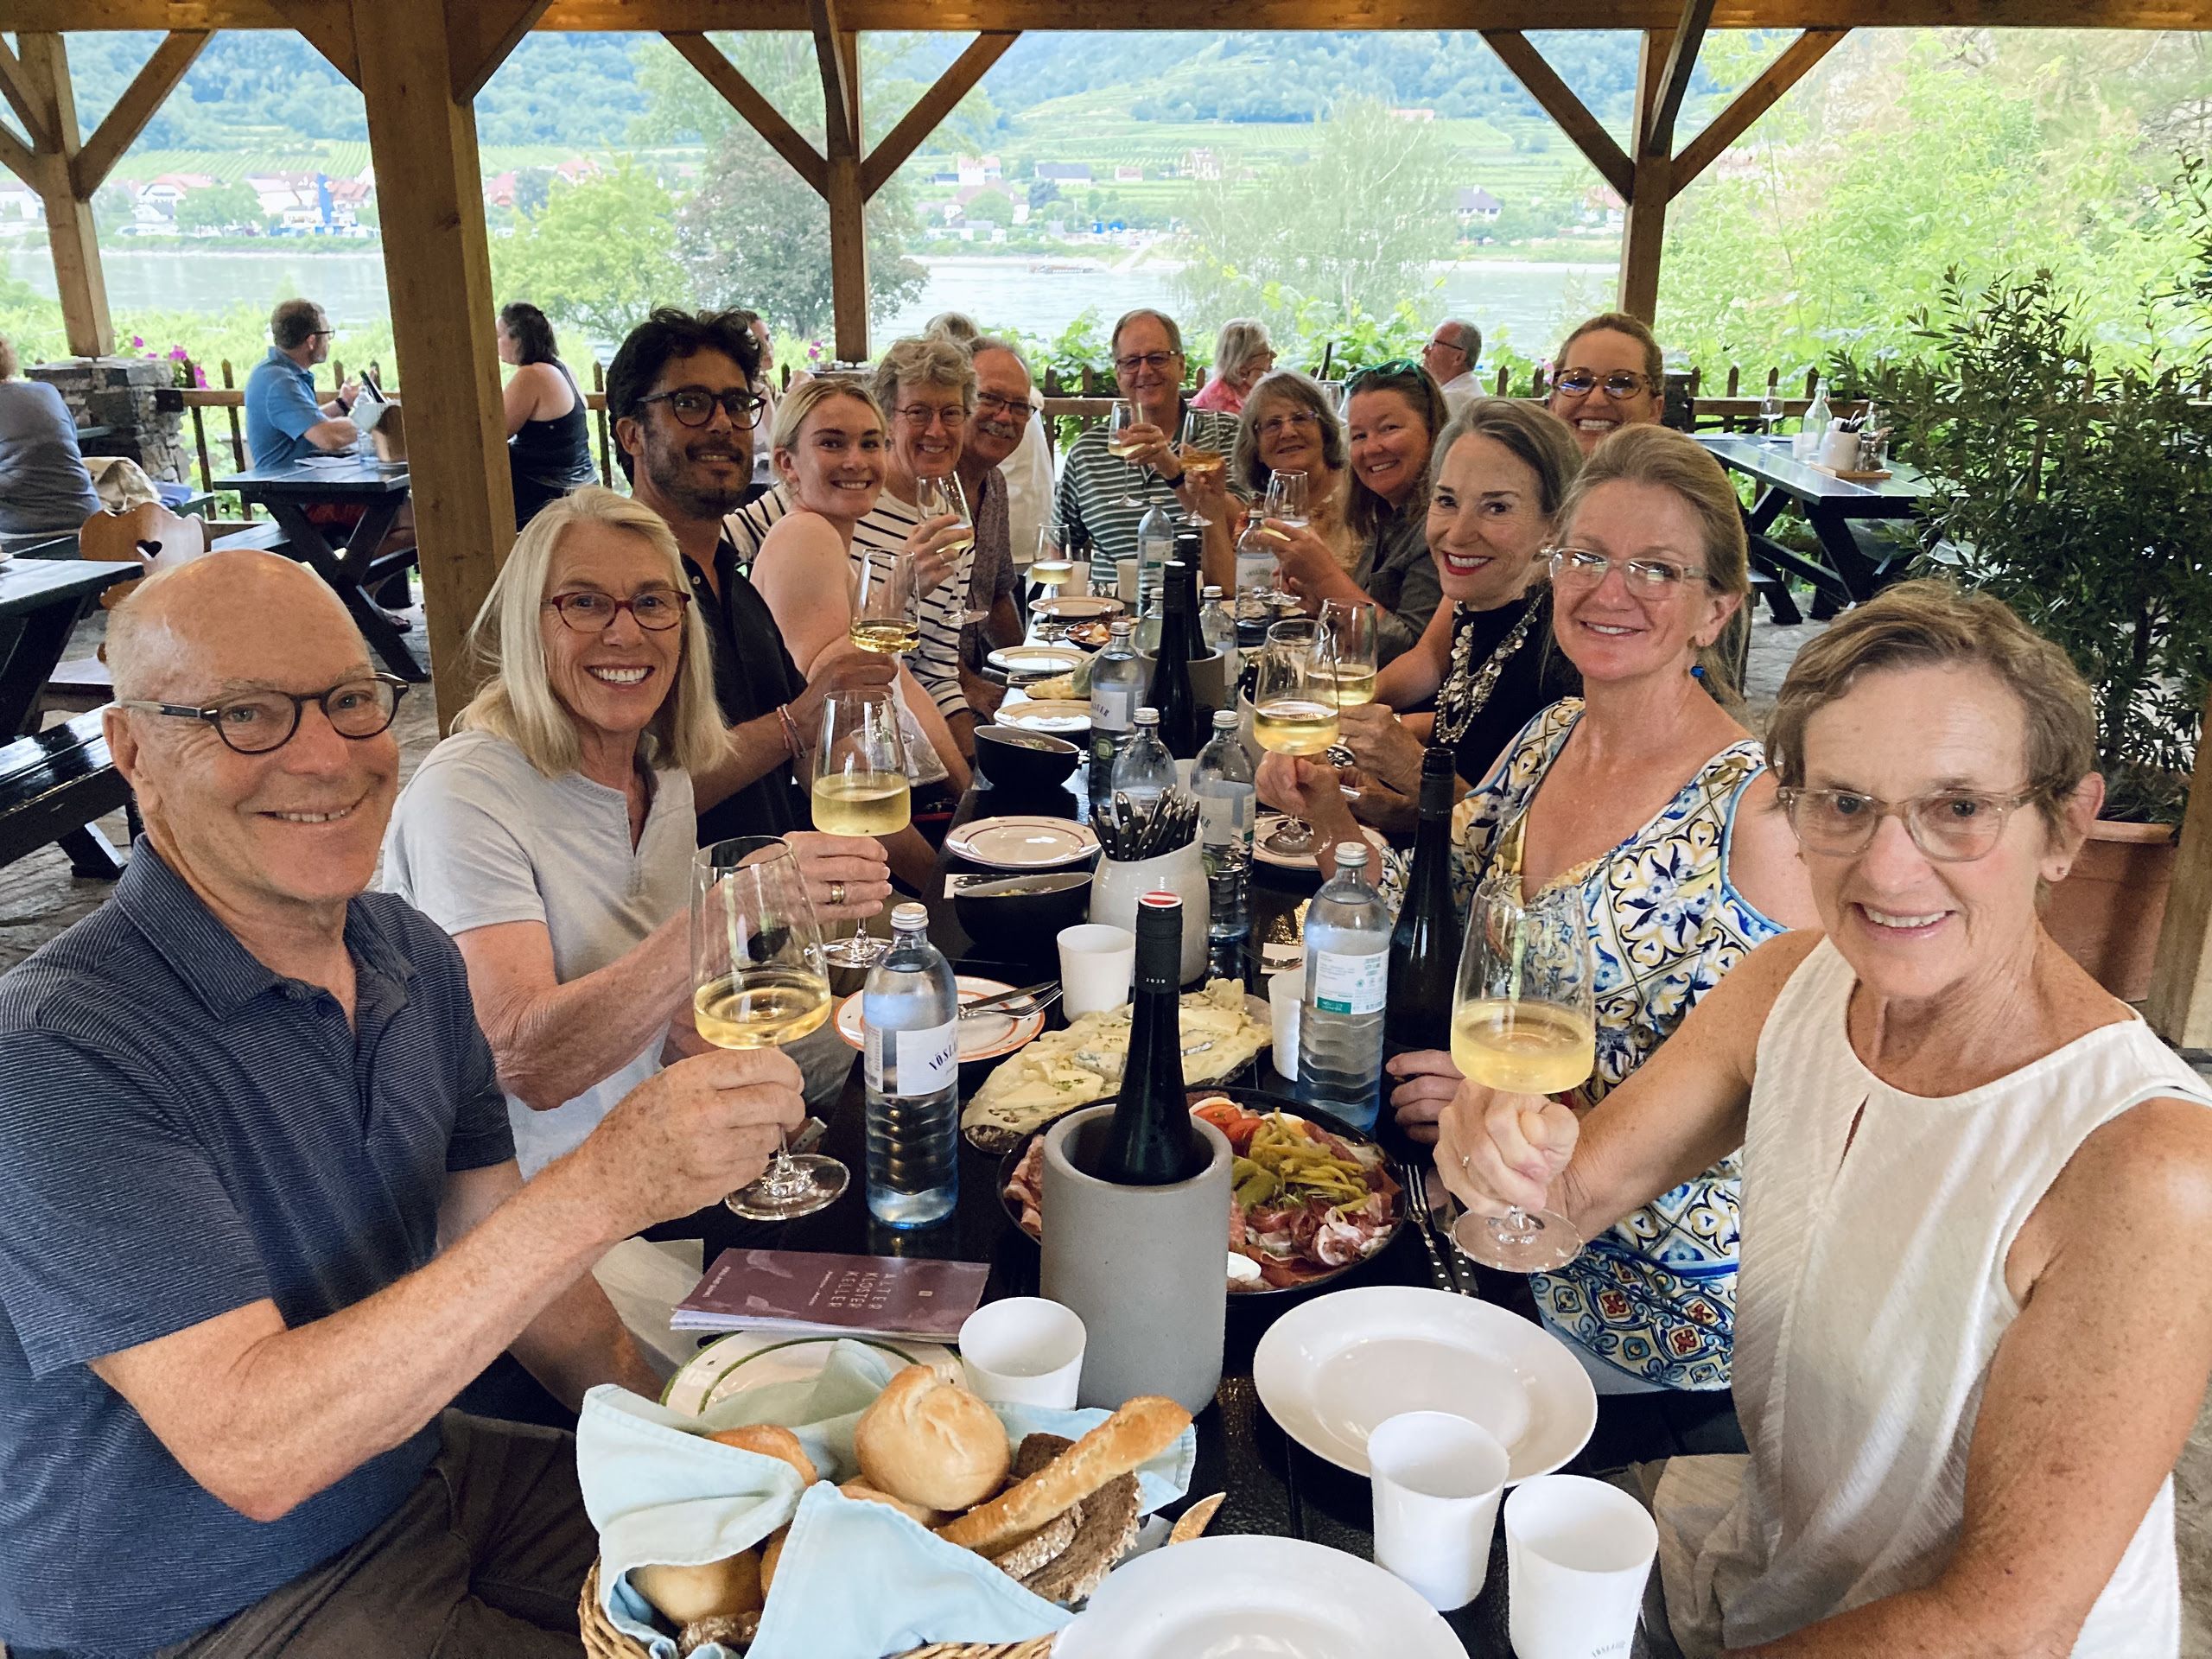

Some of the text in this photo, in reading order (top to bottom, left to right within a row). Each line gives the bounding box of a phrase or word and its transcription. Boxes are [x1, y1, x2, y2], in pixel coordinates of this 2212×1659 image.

[828, 1270, 860, 1307] KELLER
[849, 1272, 879, 1309] KLOSTER
[868, 1273, 897, 1310] ALTER
